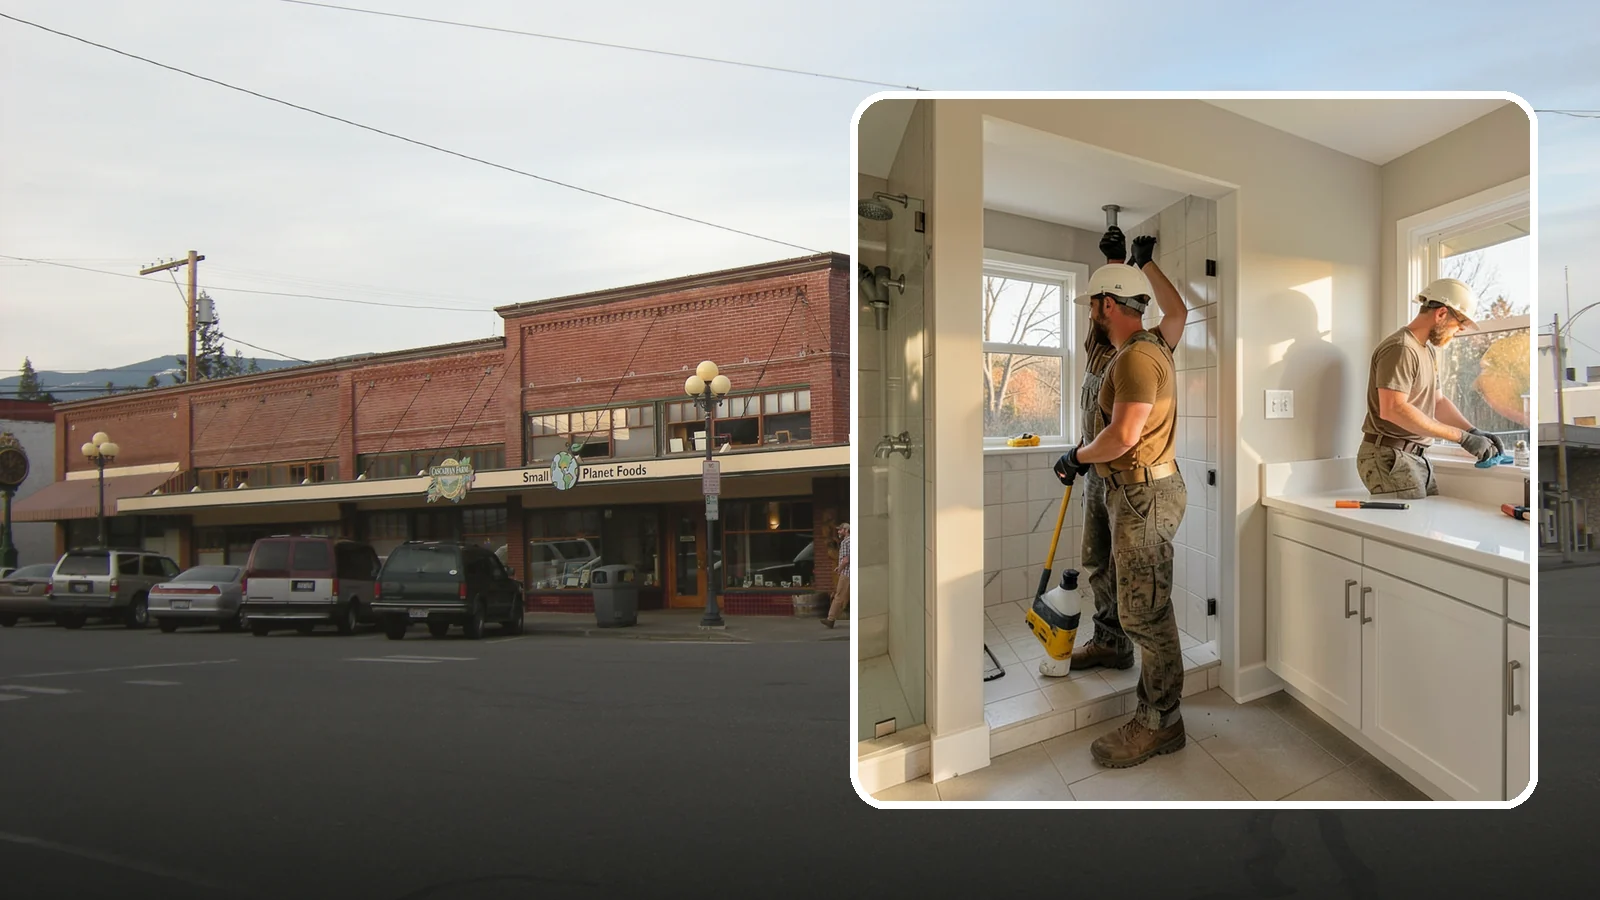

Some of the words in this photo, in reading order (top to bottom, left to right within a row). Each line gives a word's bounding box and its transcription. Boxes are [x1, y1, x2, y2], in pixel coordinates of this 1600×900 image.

[523, 471, 549, 483] Small
[583, 468, 614, 479] Planet
[617, 464, 647, 476] Foods
